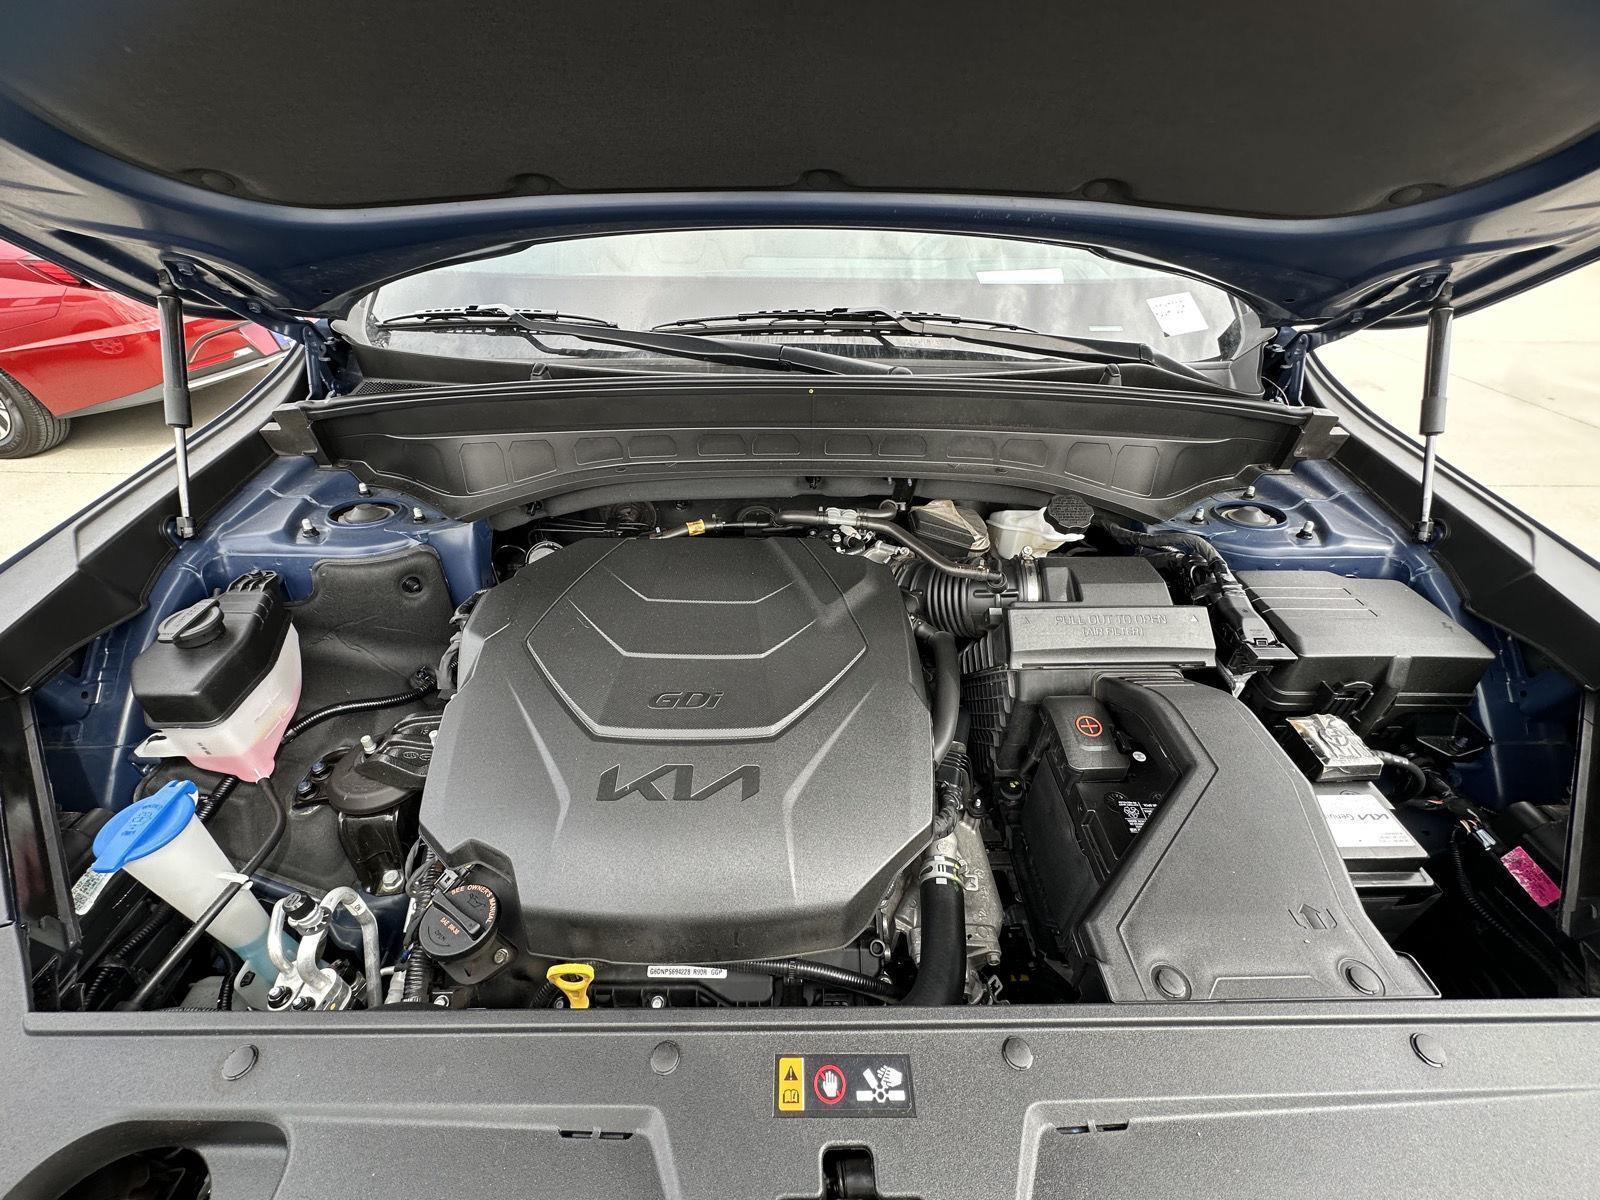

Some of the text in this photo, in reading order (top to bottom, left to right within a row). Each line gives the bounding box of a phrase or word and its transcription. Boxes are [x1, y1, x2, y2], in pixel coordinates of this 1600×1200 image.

[1055, 614, 1168, 625] PULL OUT TO OPEN
[648, 691, 725, 709] GDi
[596, 763, 761, 802] KIA
[485, 897, 497, 924] MANUAL
